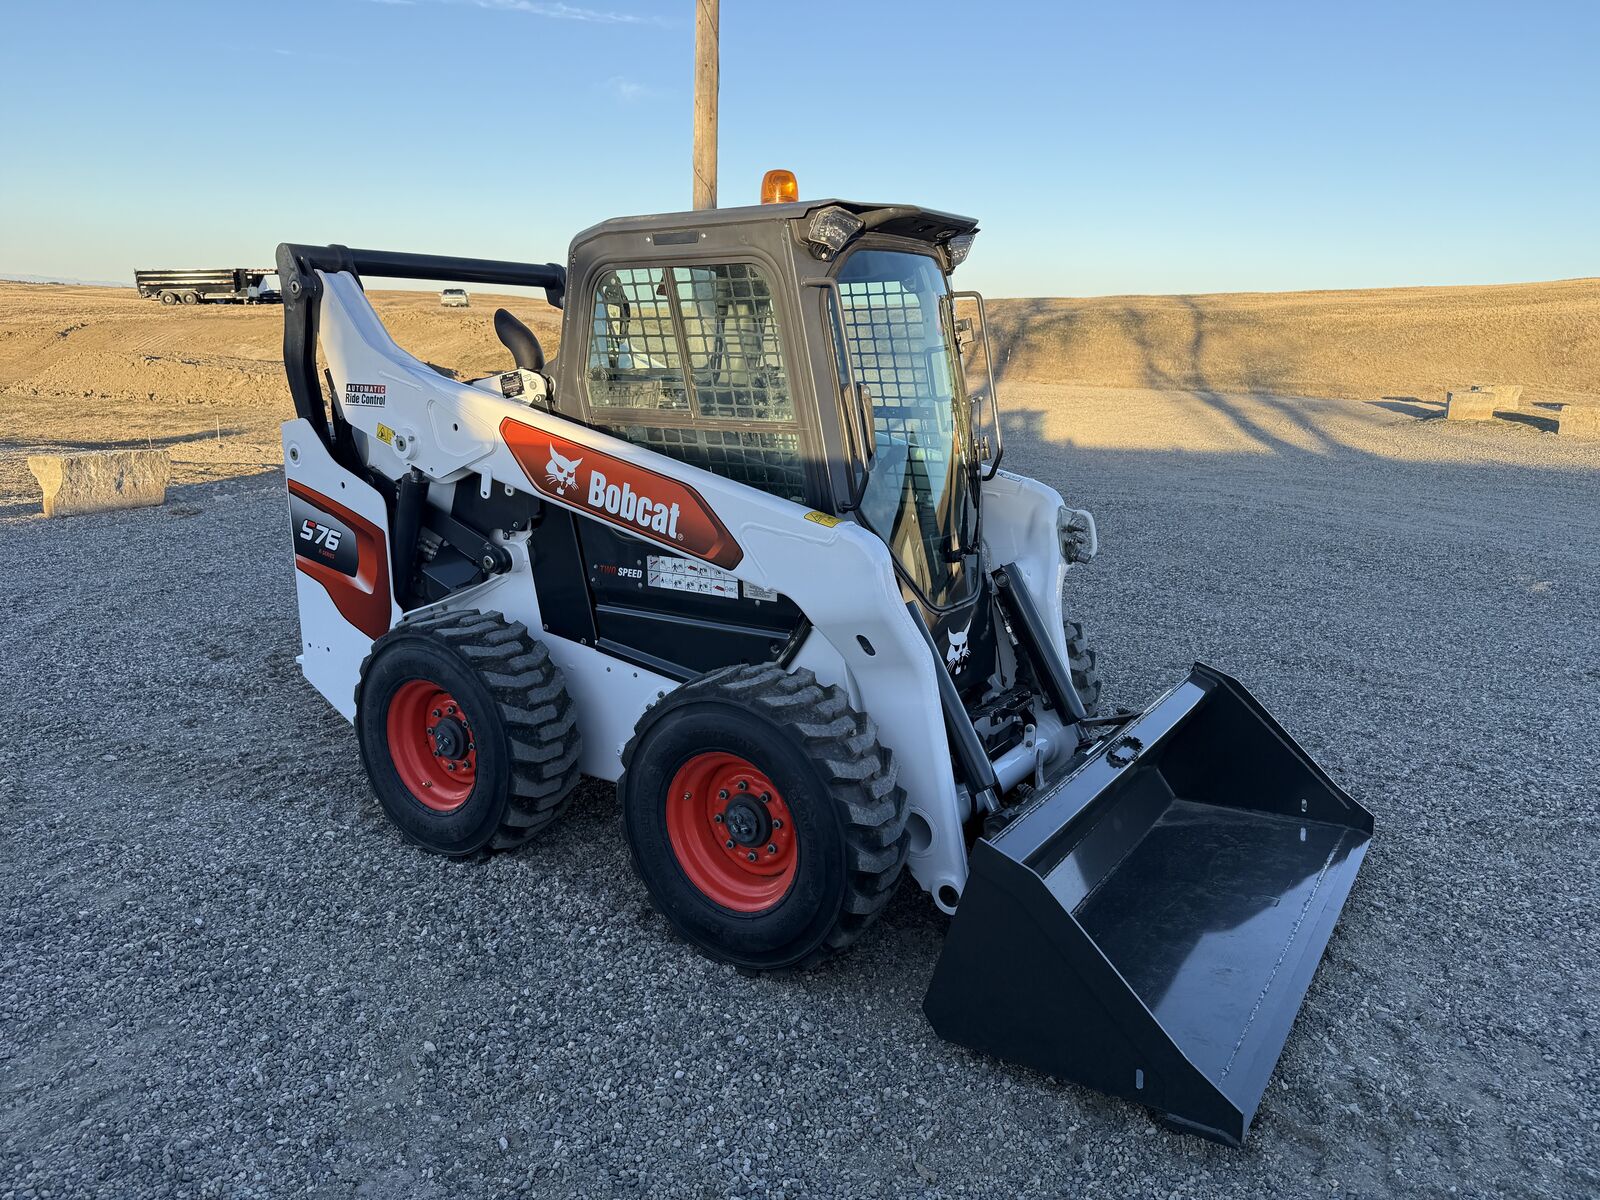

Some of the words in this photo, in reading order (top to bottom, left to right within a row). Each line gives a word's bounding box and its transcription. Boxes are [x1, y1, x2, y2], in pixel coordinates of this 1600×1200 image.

[347, 385, 385, 393] AUTOMATIC
[345, 393, 360, 404] Ride
[361, 394, 386, 405] Control
[588, 469, 680, 539] Bobcat
[300, 519, 342, 551] S76
[600, 564, 617, 574] TWO
[617, 566, 643, 579] SPEED
